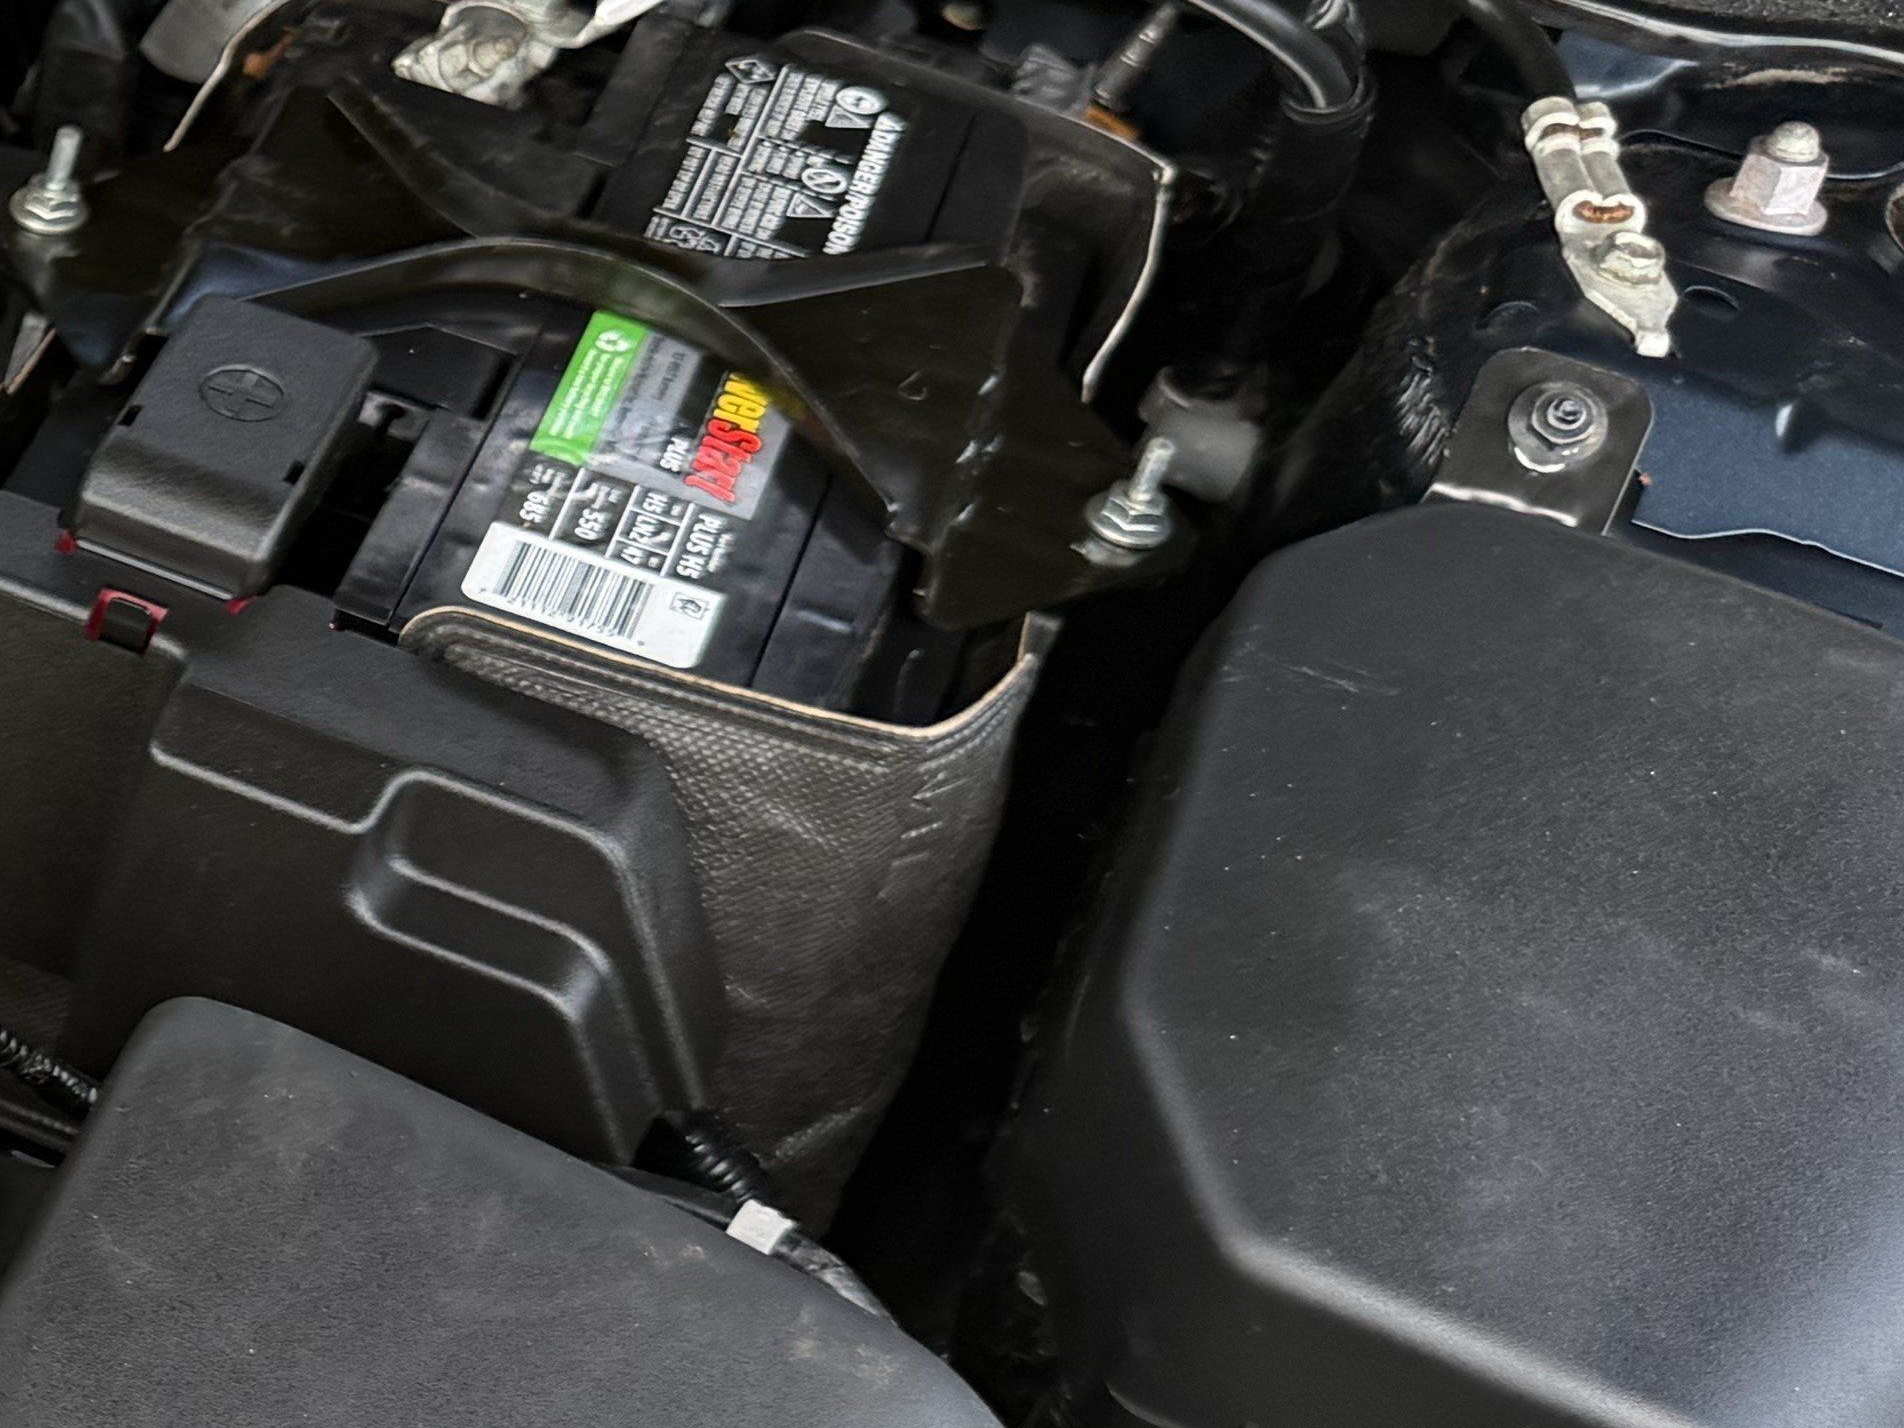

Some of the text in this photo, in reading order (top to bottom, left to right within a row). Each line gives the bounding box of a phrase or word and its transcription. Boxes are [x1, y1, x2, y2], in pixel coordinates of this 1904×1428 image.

[659, 436, 691, 473] PLUS
[683, 373, 769, 504] verStart
[519, 491, 551, 524] 685
[574, 508, 609, 541] 550
[685, 512, 726, 556] PLUS
